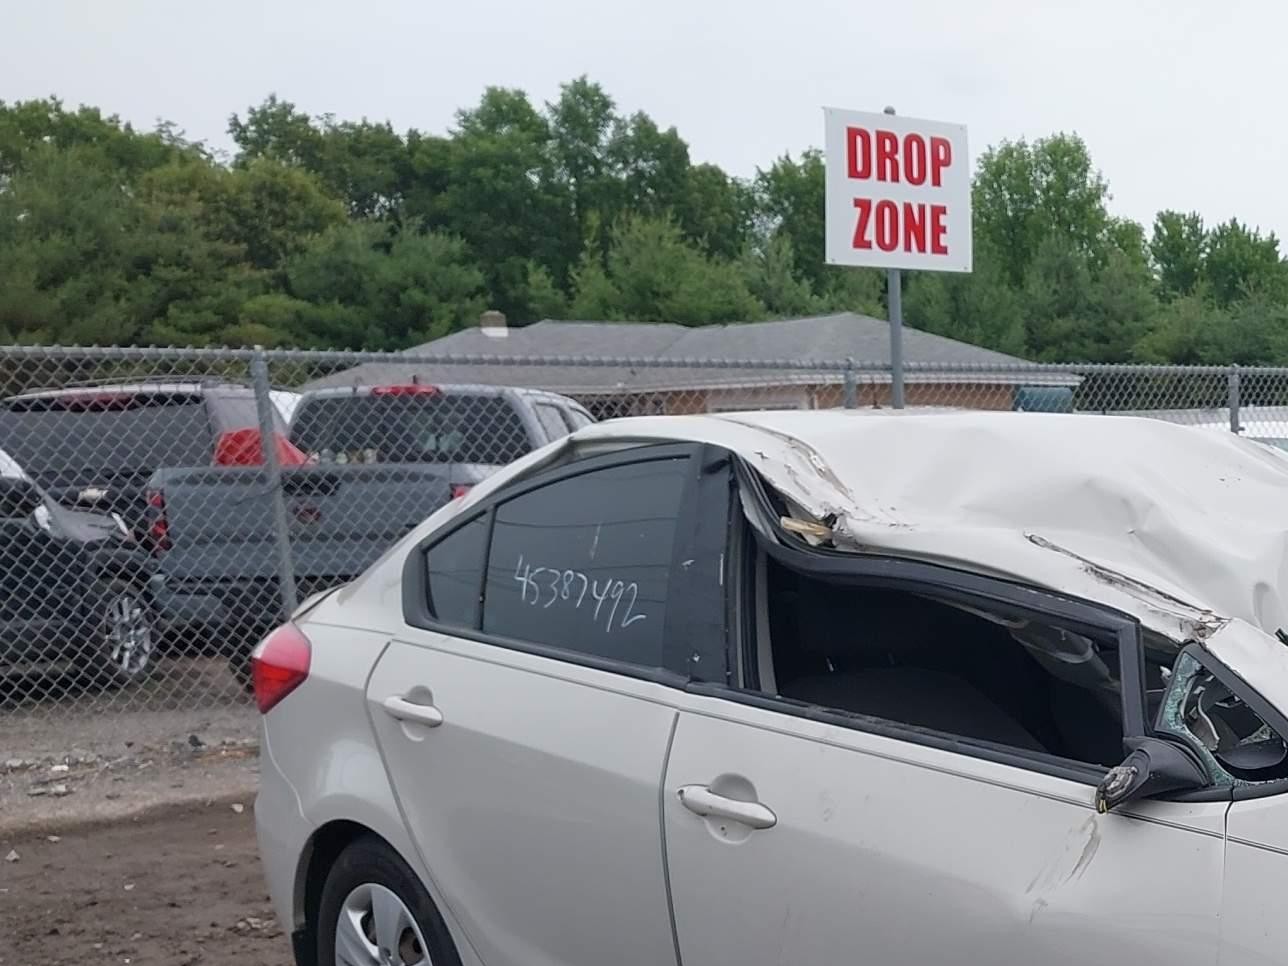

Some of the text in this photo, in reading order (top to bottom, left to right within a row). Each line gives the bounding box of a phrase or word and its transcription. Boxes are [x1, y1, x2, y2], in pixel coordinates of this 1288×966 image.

[846, 125, 952, 188] DROP
[852, 197, 948, 256] ZONE
[513, 554, 647, 632] 45387492
